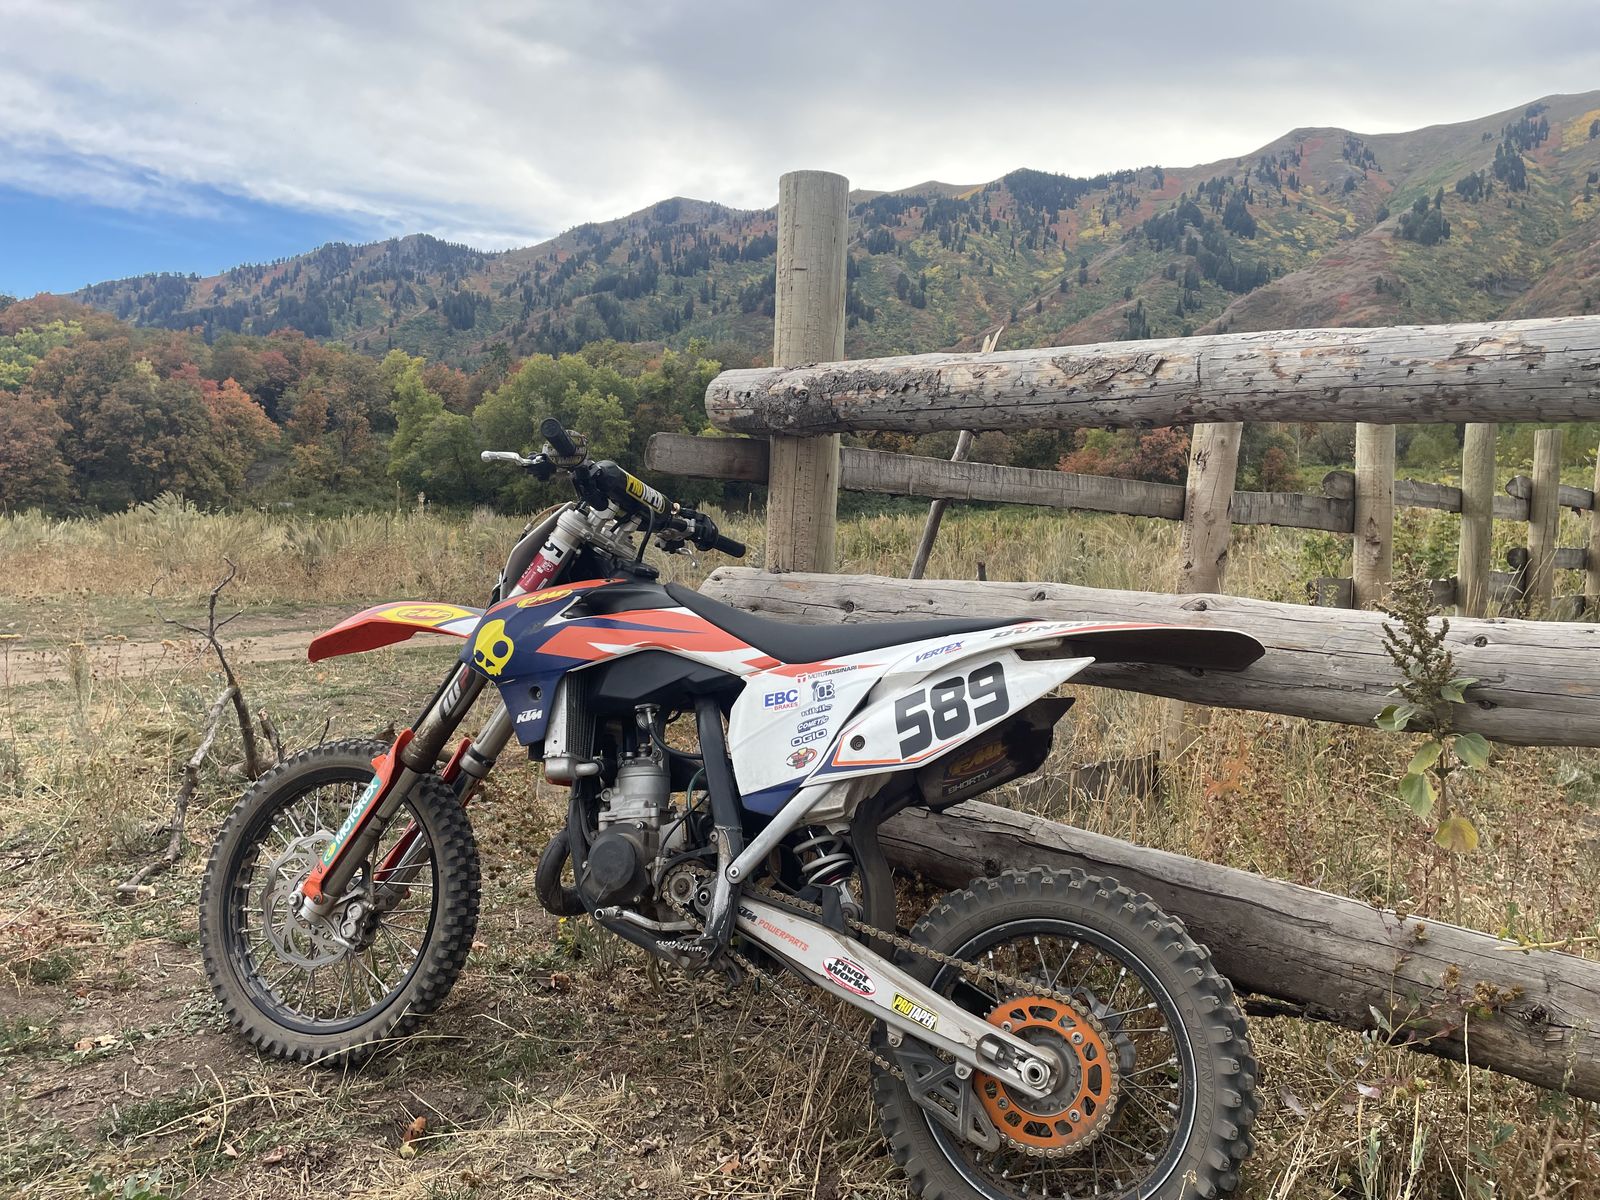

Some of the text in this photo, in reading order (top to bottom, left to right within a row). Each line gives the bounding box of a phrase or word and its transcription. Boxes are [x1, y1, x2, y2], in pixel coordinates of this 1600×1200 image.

[915, 640, 965, 663] VERTEX
[807, 665, 858, 680] MOTOTASSINARI
[764, 689, 799, 707] EBC
[774, 702, 799, 711] BRAKES
[894, 661, 1010, 759] 589
[516, 709, 543, 724] KTM
[791, 729, 828, 747] OGIO
[948, 769, 990, 794] SHORTY
[335, 781, 379, 845] MOTOREX
[757, 918, 809, 952] POWERPARTS
[826, 962, 872, 994] Works
[833, 958, 870, 984] Pivot
